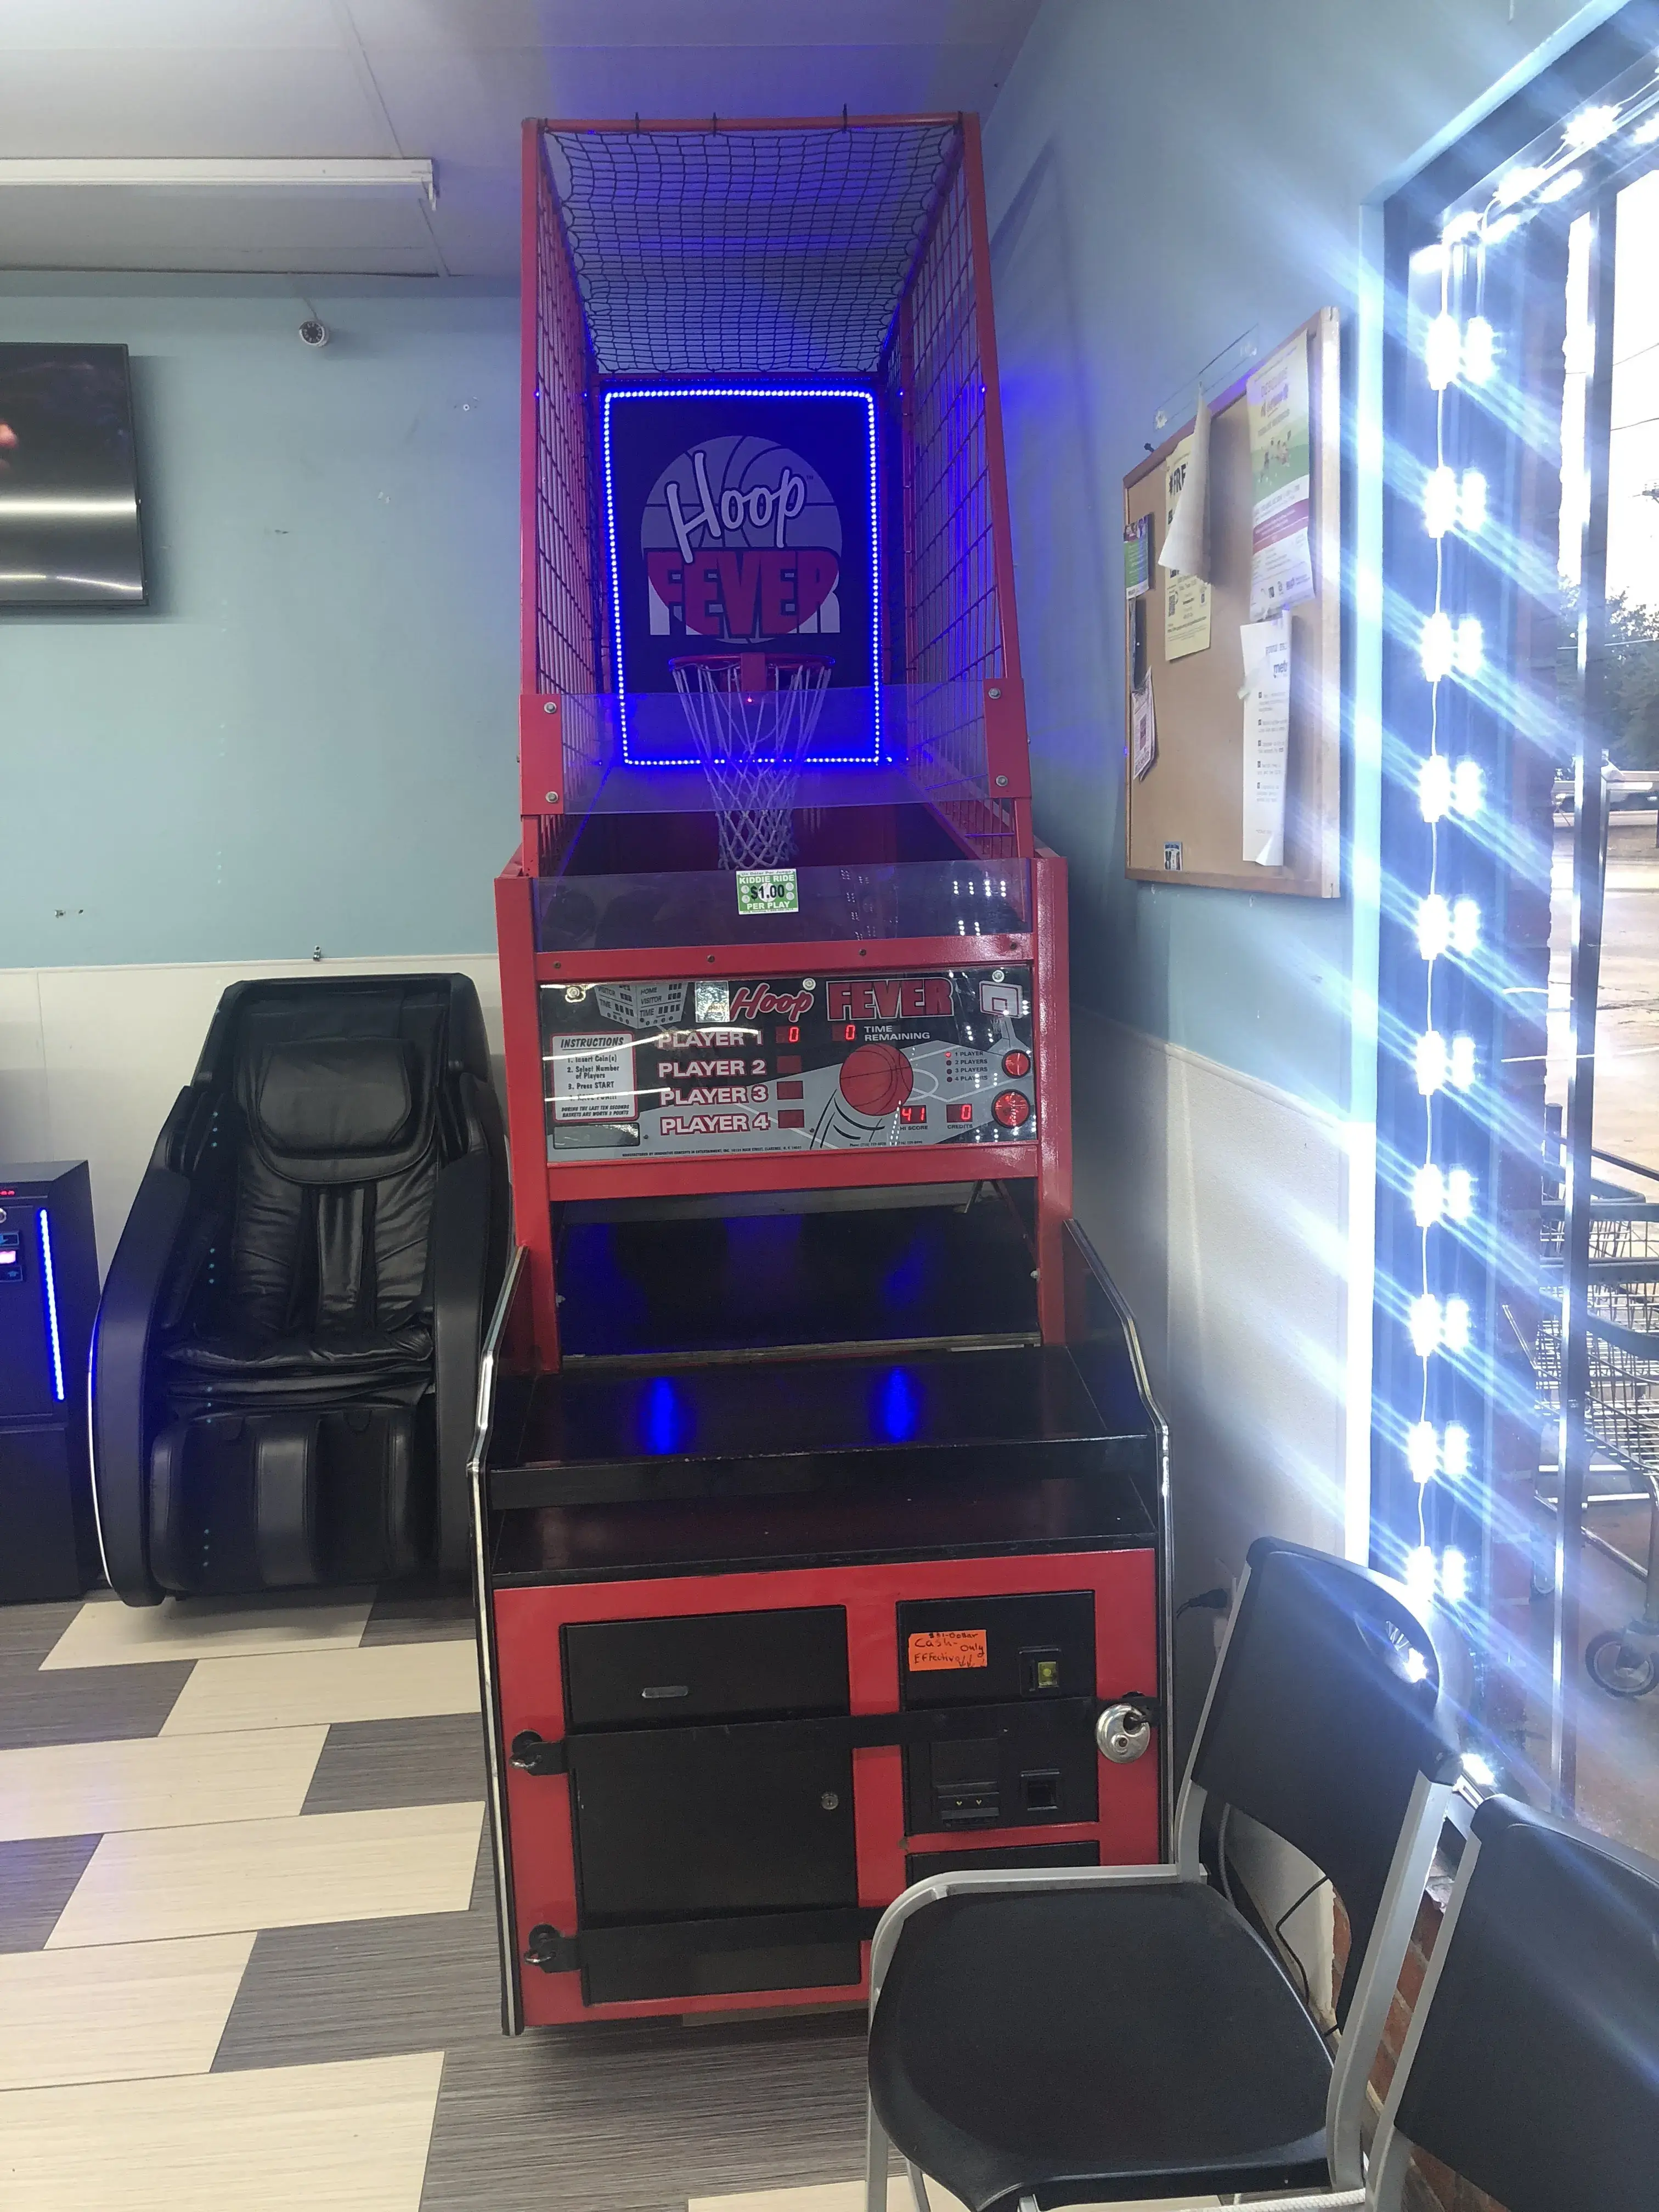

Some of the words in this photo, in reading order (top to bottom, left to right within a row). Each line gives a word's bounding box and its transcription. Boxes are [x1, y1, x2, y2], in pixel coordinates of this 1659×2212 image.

[665, 452, 806, 564] Hoop
[647, 550, 840, 636] FEVER
[739, 876, 771, 884] KIDDIE
[751, 884, 785, 901] $1.00
[641, 996, 662, 1005] VISITOR
[730, 983, 815, 1023] Hoop
[826, 977, 954, 1021] FEVER
[640, 1008, 654, 1018] TIME
[658, 1031, 745, 1049] PLAYER
[788, 1026, 799, 1042] 0
[845, 1024, 856, 1041] 0
[865, 1032, 931, 1041] REMAINING
[560, 1037, 624, 1048] INSTRUCTIONS
[595, 1054, 617, 1063] Coin(s)
[583, 1072, 606, 1081] Players
[658, 1059, 746, 1079] PLAYER
[752, 1059, 766, 1075] 2
[594, 1081, 614, 1089] START
[660, 1086, 749, 1107] PLAYER
[752, 1085, 768, 1101] 3
[901, 1107, 926, 1122] 41
[961, 1104, 971, 1120] 0
[660, 1113, 750, 1135] PLAYER
[753, 1113, 770, 1130] 4
